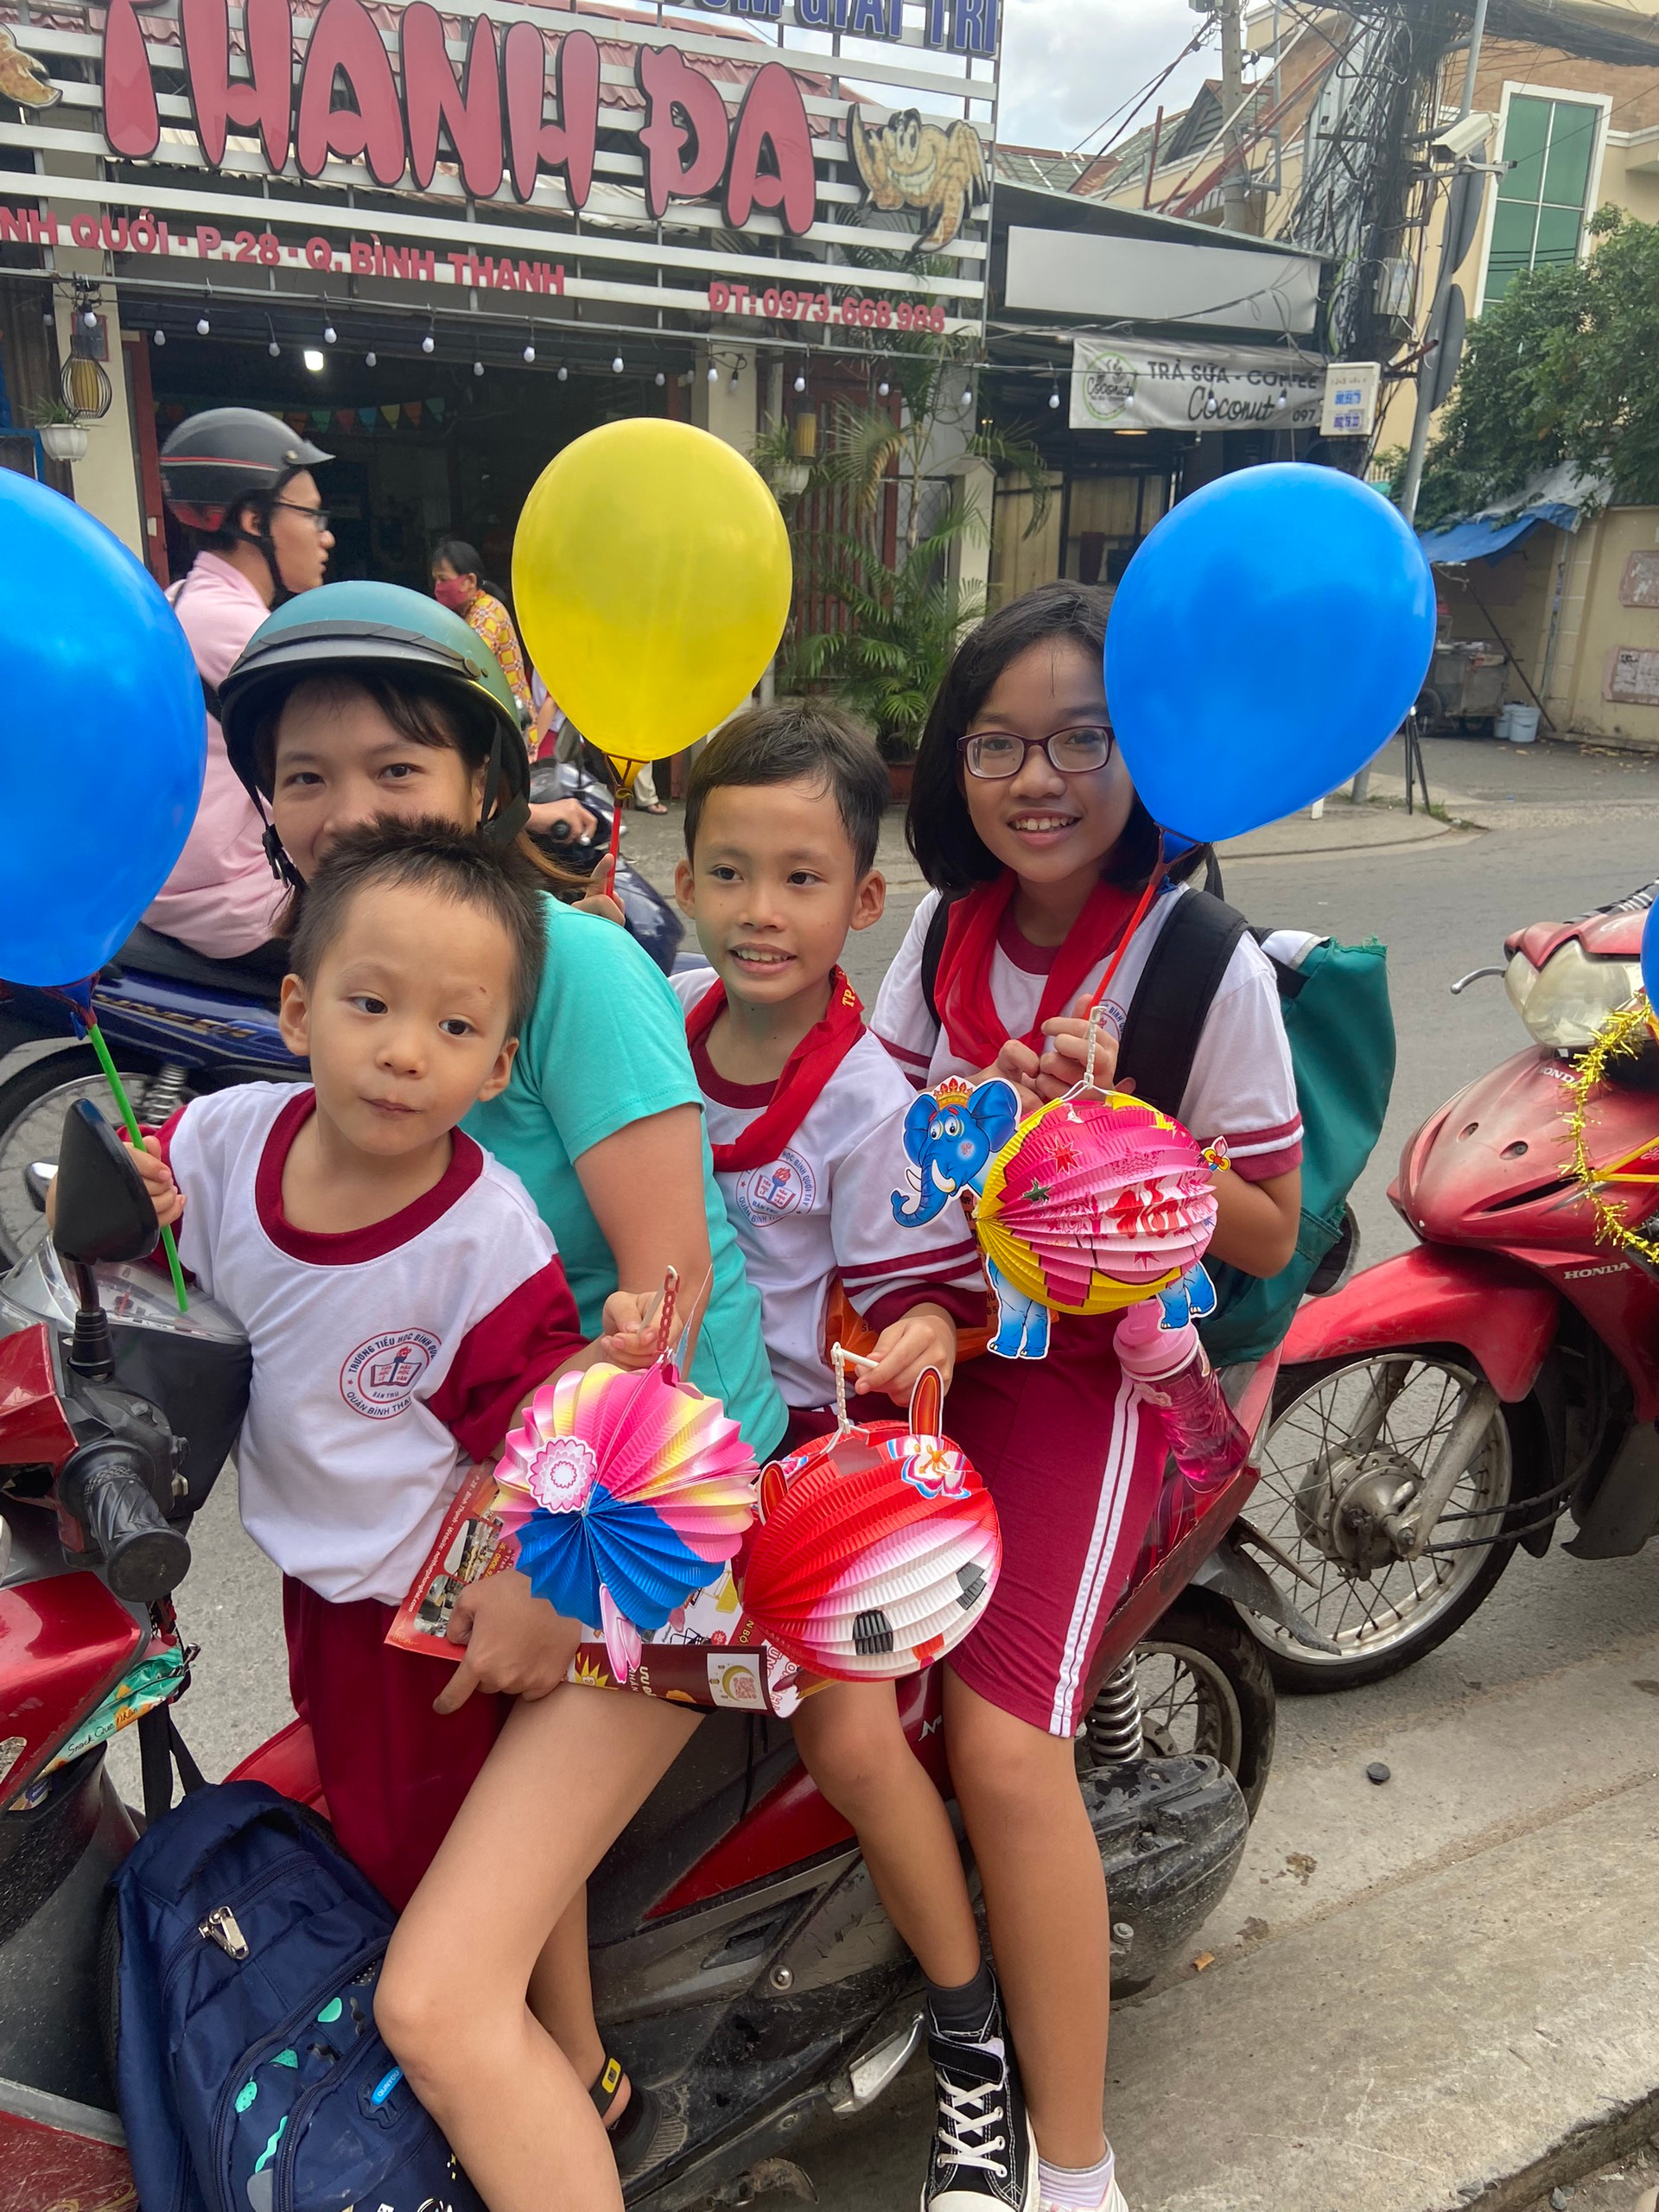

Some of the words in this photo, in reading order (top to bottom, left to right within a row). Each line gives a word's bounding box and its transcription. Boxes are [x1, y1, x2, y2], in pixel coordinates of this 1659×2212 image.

[635, 42, 817, 236] ĐA
[1147, 359, 1185, 380] TRÀ
[1187, 385, 1275, 422] Coconut
[1539, 1065, 1577, 1084] HOND
[1564, 1262, 1631, 1280] HONDA
[67, 1737, 94, 1757] Snack
[94, 1723, 115, 1738] Que
